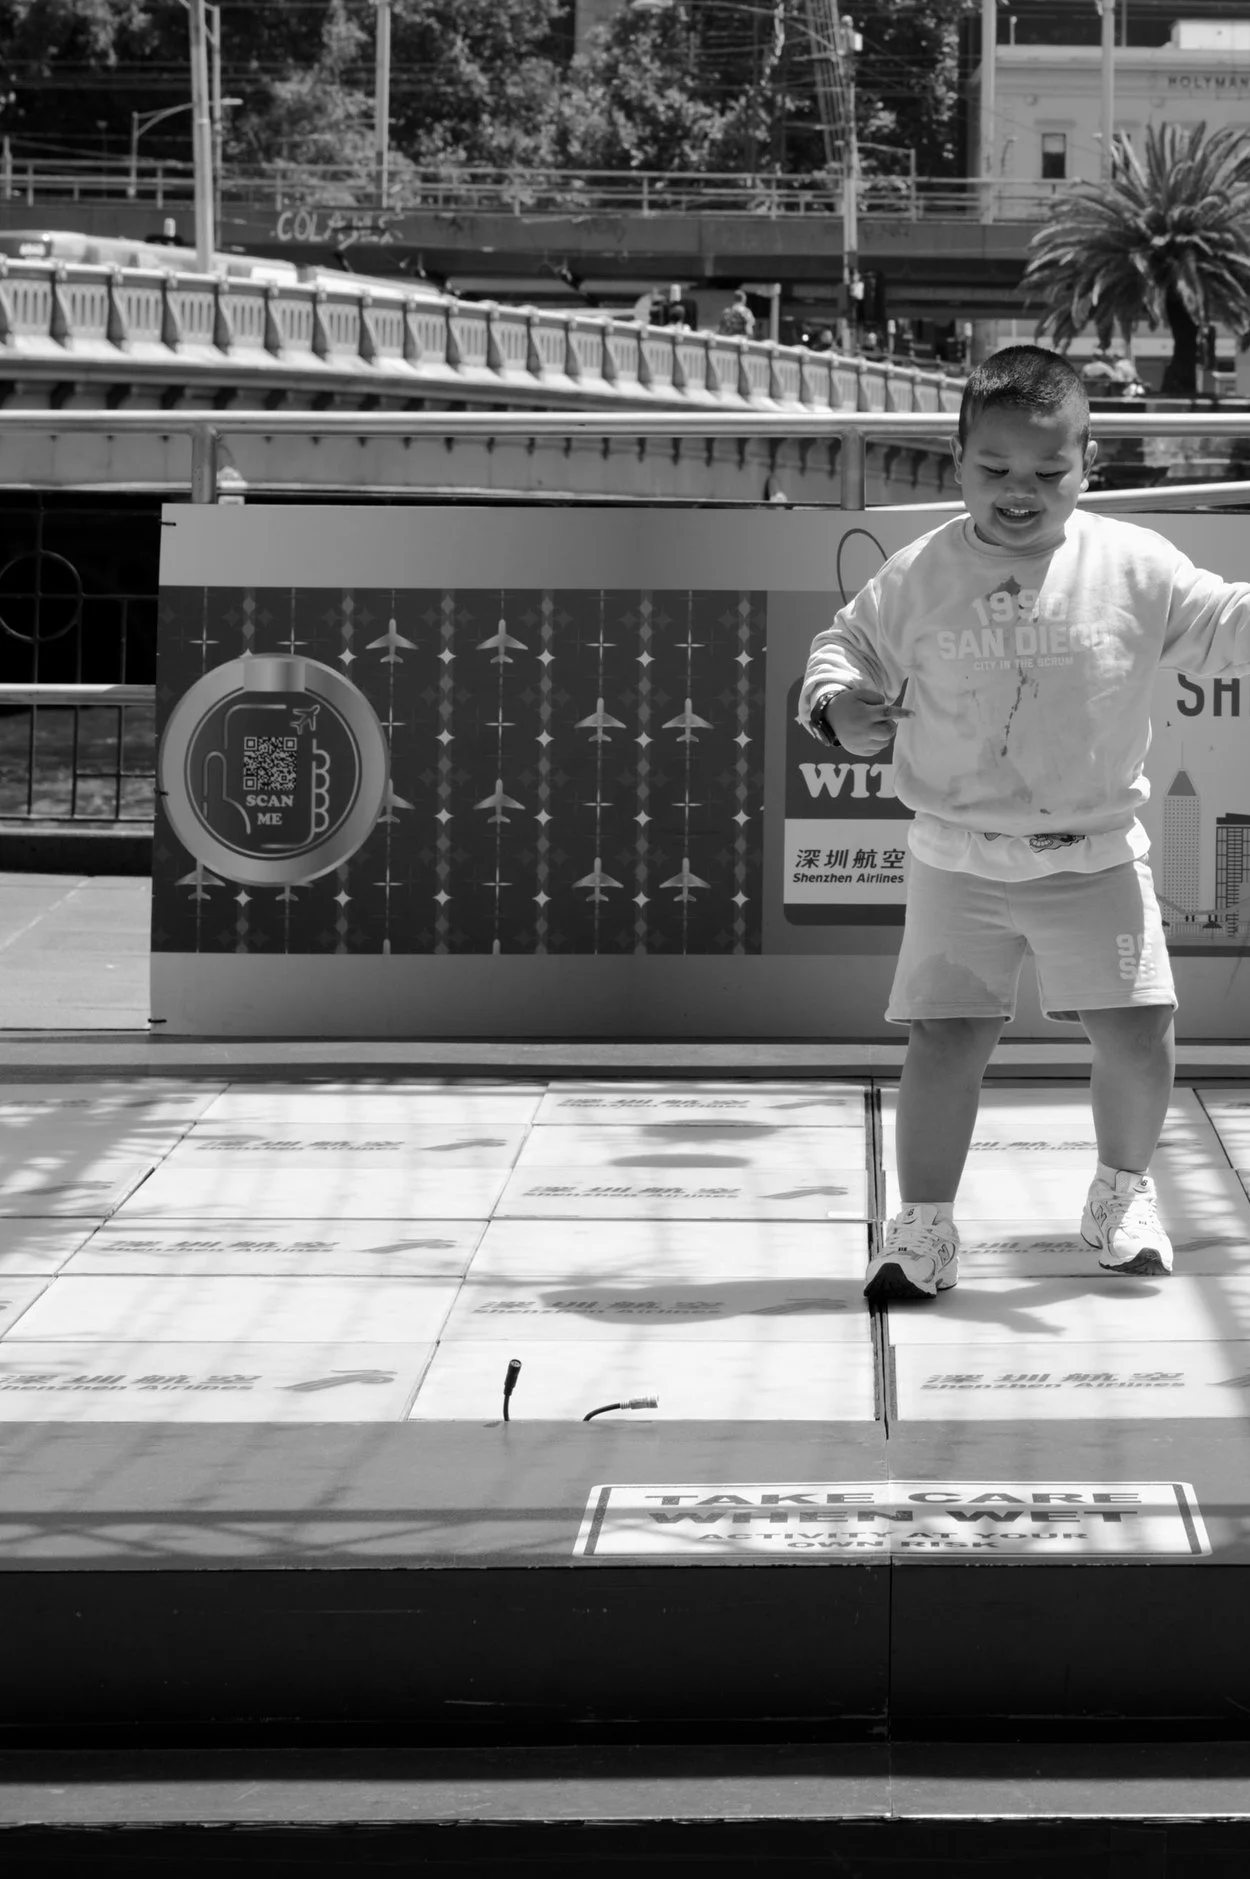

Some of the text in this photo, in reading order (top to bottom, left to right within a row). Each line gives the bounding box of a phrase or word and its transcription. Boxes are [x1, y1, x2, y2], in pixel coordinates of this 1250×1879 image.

[1167, 75, 1250, 91] HOLYMAN
[936, 626, 1006, 661] SAN
[798, 762, 898, 799] WIT
[245, 794, 294, 807] SCAN
[257, 812, 283, 825] ME
[795, 848, 906, 869] 深圳航空
[792, 872, 905, 884] Shenzhen Airlines
[925, 1372, 1185, 1383] 深圳航空
[644, 1491, 1142, 1506] TAKE CARE
[647, 1510, 1138, 1524] WHEN WET
[697, 1531, 1089, 1540] ACTIVITY AT YOUR
[787, 1540, 1000, 1548] OWN RISK
